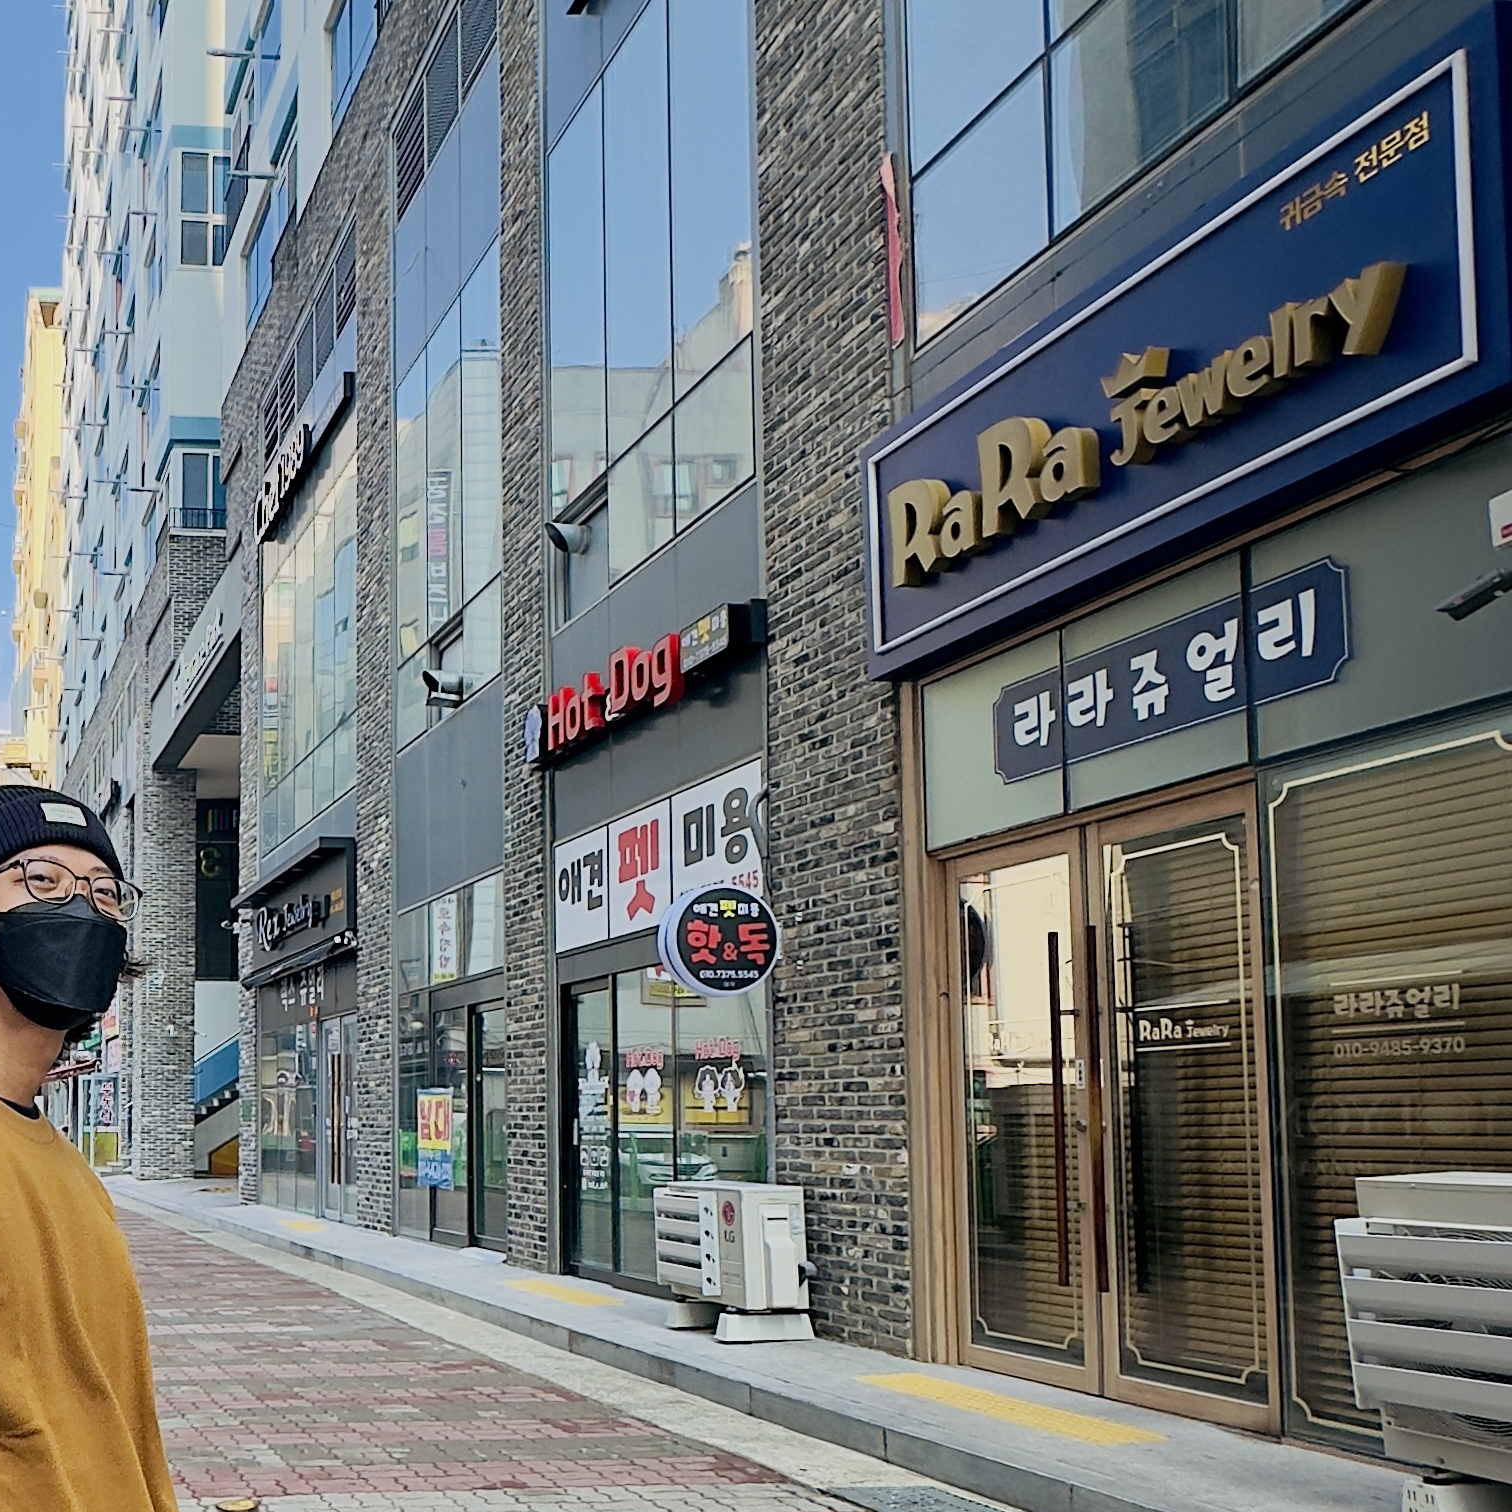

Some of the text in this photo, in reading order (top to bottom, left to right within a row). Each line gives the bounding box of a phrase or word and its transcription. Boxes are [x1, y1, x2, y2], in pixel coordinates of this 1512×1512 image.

[1279, 110, 1430, 231] 귀금속 전문점
[888, 416, 1101, 588] RaRa
[548, 671, 606, 751] Hot
[609, 632, 685, 714] Dog
[1012, 587, 1317, 748] 라라쥬얼리
[558, 787, 750, 921] 애견 펫 미용
[1138, 1016, 1183, 1042] RaRa
[1333, 982, 1461, 1020] 라라쥬얼리
[1333, 1036, 1467, 1060] 010-9485-9370
[419, 1099, 450, 1141] 임대
[723, 1229, 736, 1244] LG
